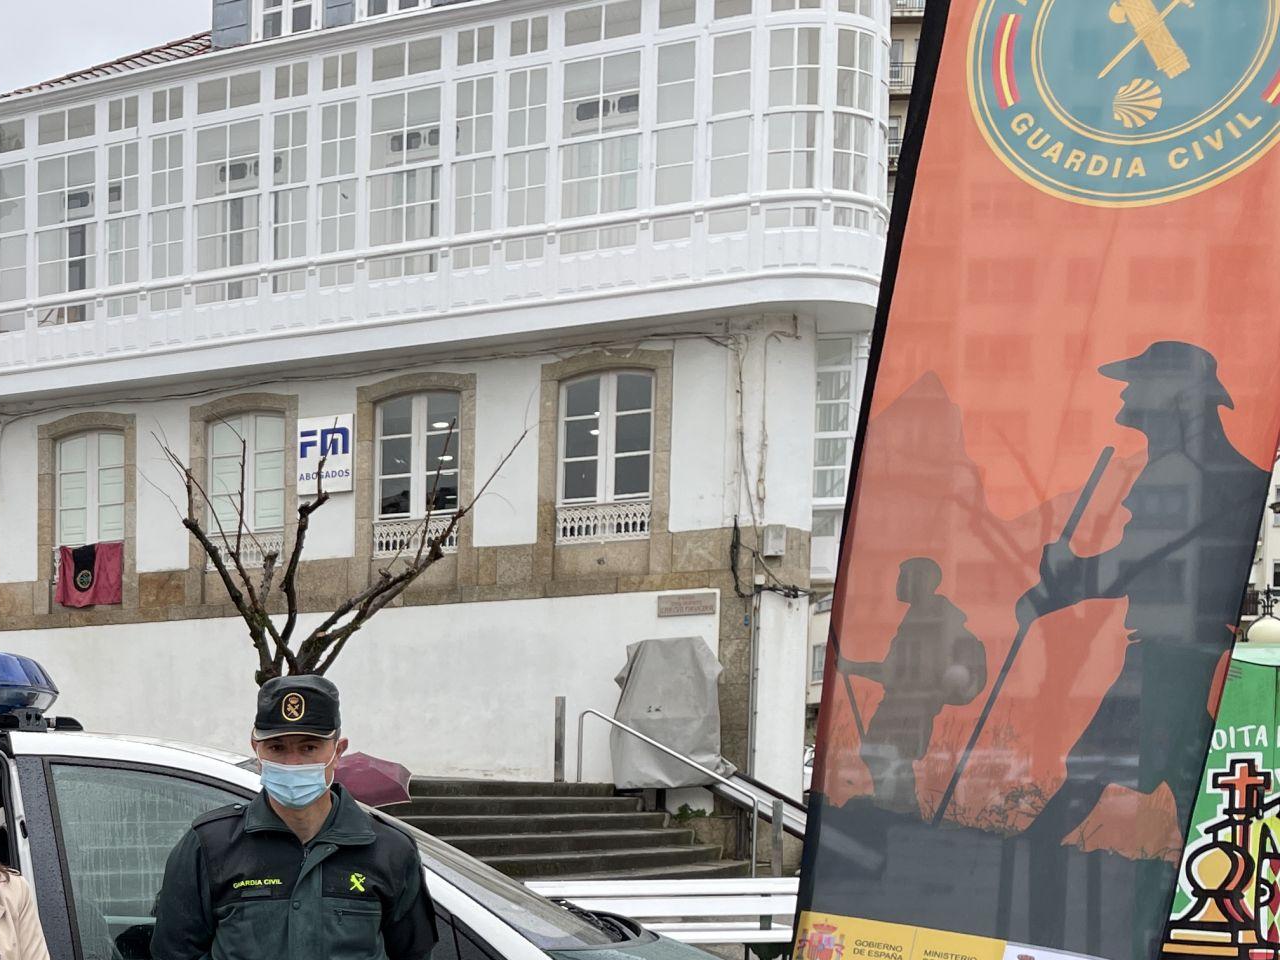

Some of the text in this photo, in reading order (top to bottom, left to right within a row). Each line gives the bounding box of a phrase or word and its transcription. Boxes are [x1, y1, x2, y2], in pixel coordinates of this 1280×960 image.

[1010, 112, 1262, 178] GUARDIA CIVIL
[300, 426, 350, 458] FM
[299, 469, 350, 481] ABOGADOS
[1209, 725, 1269, 753] OITA
[853, 947, 866, 956] DE
[854, 939, 903, 953] GOBIERNO
